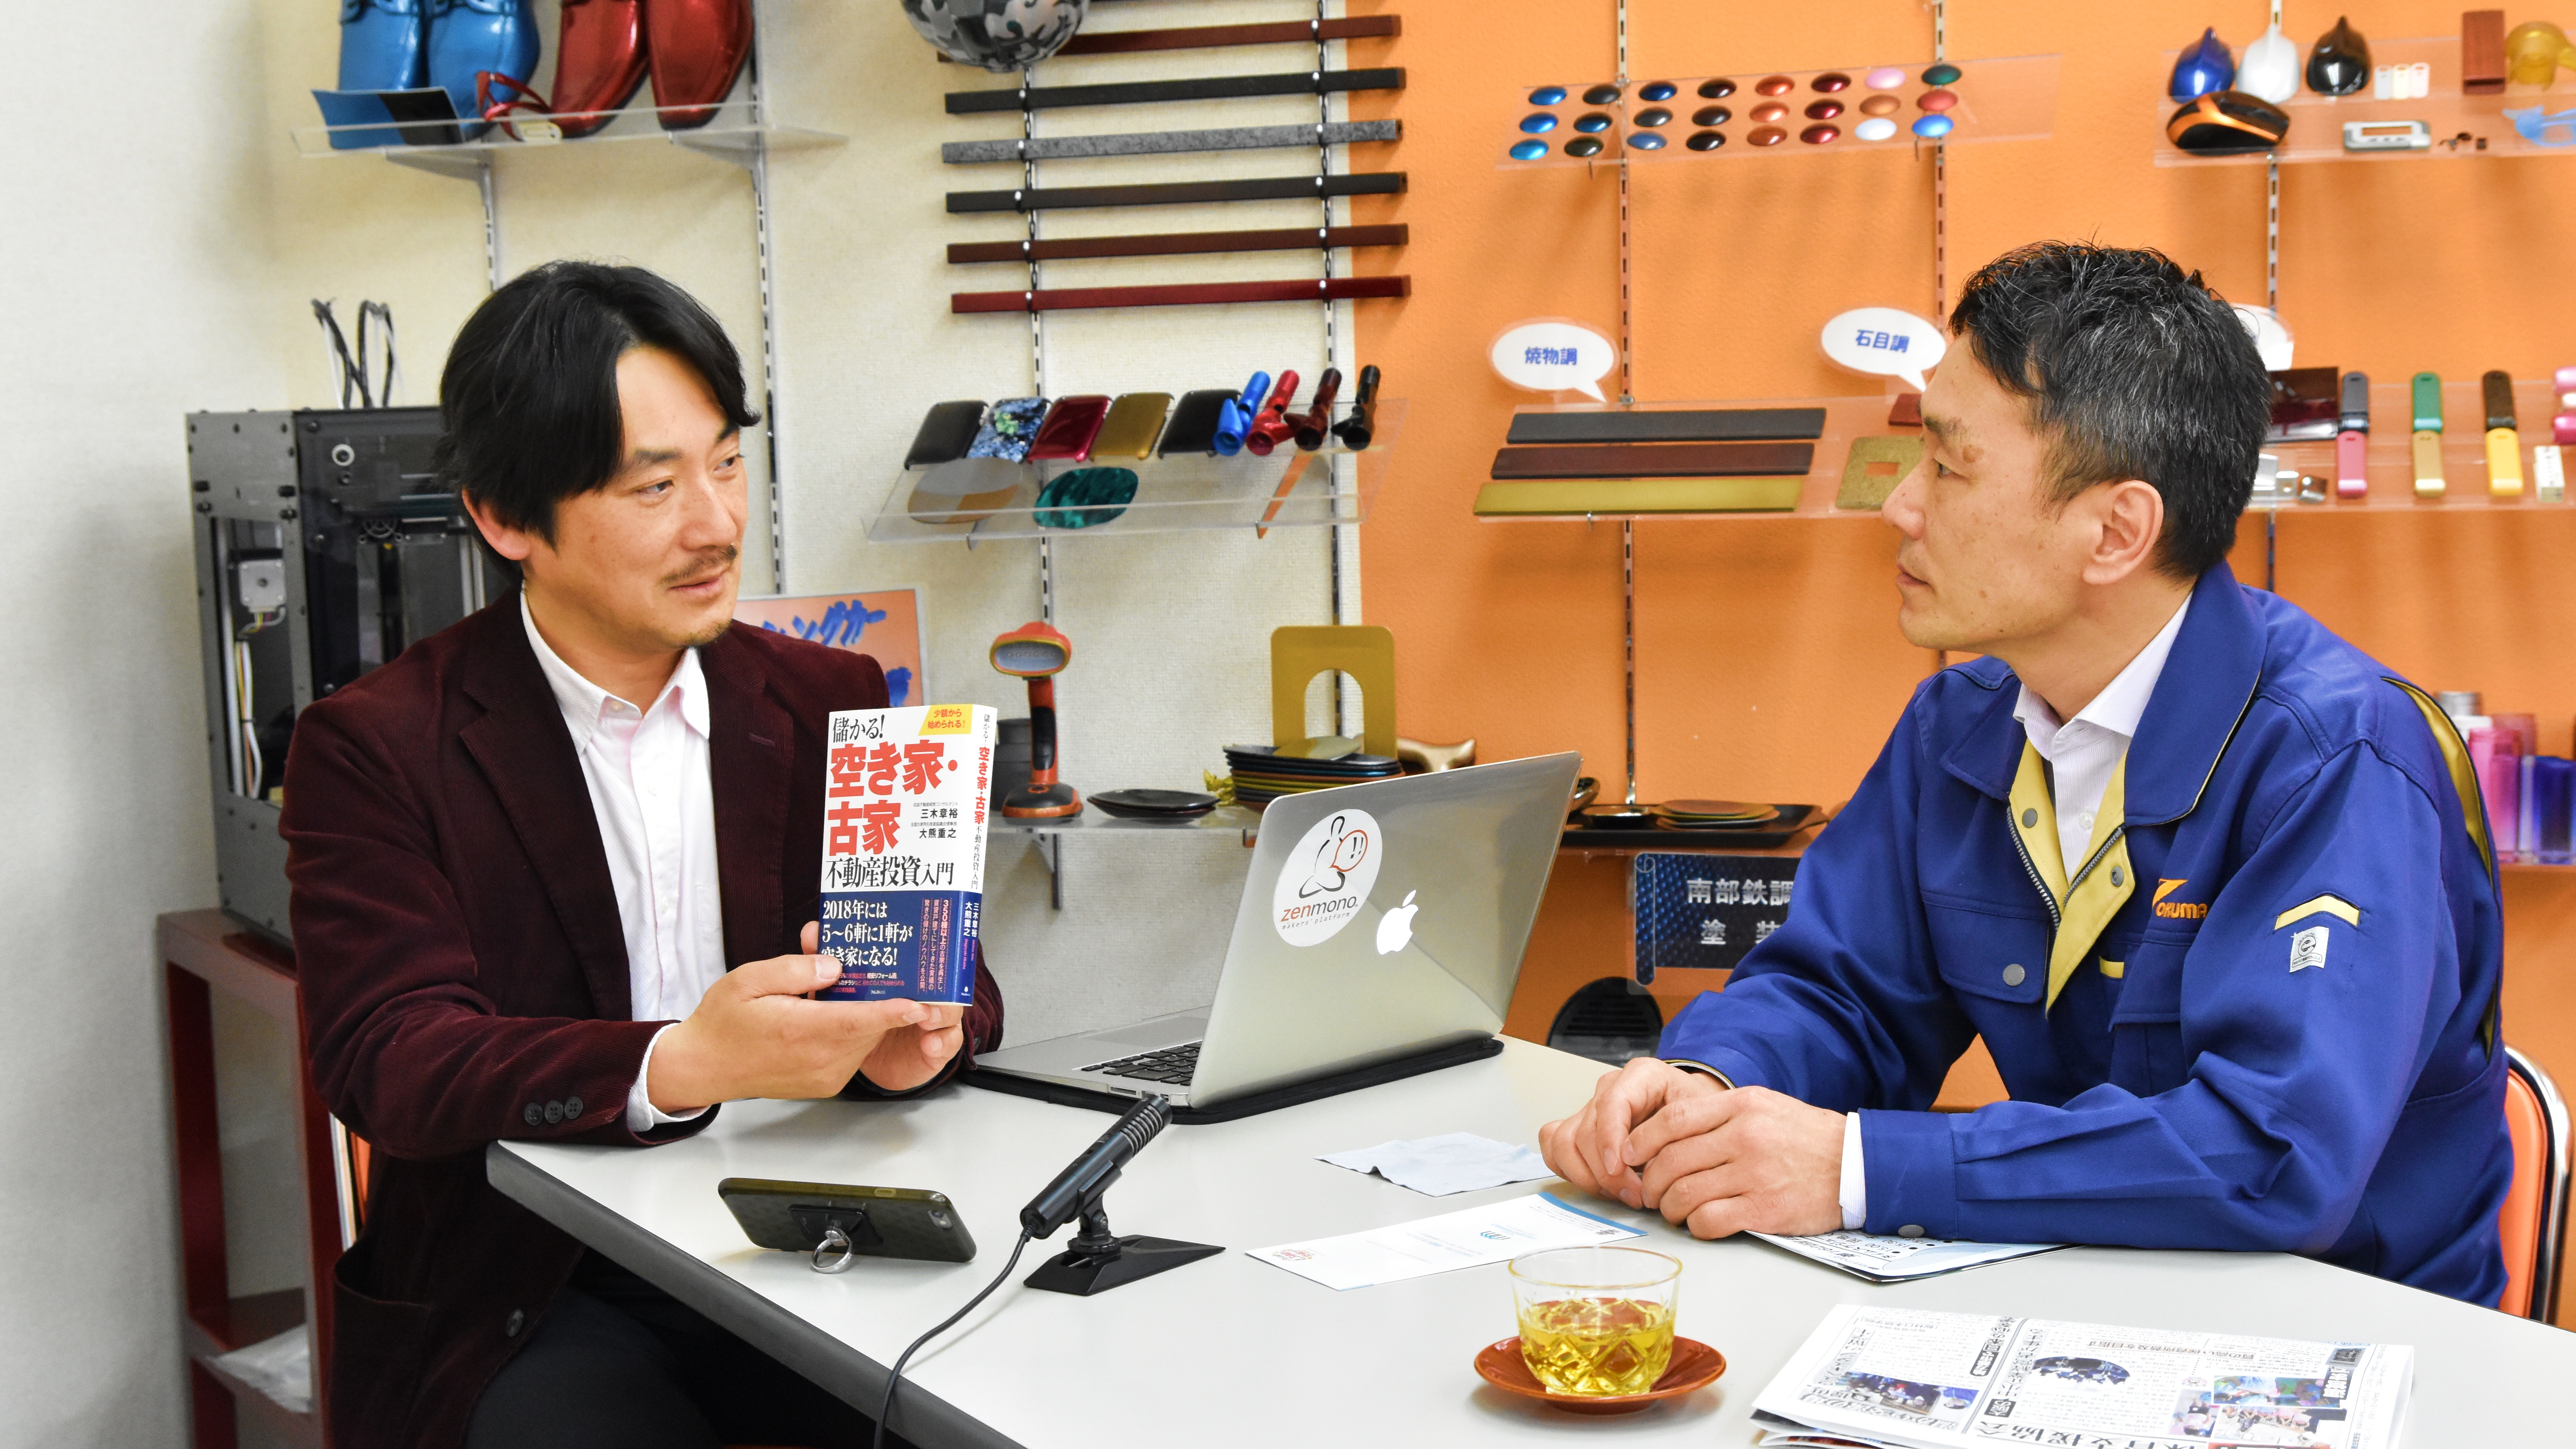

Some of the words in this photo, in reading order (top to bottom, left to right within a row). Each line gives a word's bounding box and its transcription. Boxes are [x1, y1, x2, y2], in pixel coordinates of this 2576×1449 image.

[1856, 329, 1910, 353] 石目調
[1525, 346, 1578, 365] 焼物調
[927, 719, 966, 729] 始められる！
[934, 708, 962, 718] 少額から
[832, 714, 884, 743] 儲かる！
[829, 739, 958, 798] 空き家・
[920, 808, 958, 819] 三木章裕
[828, 799, 901, 856] 古家
[919, 828, 957, 839] 大熊重之
[826, 856, 954, 889] 不動産投資入門
[1687, 878, 1794, 905] 南部鉄調
[823, 900, 887, 921] 2018年には
[963, 901, 973, 937] 大熊重之
[971, 902, 980, 938] 三木章裕
[1281, 896, 1357, 922] zenmono
[1314, 911, 1351, 925] platform
